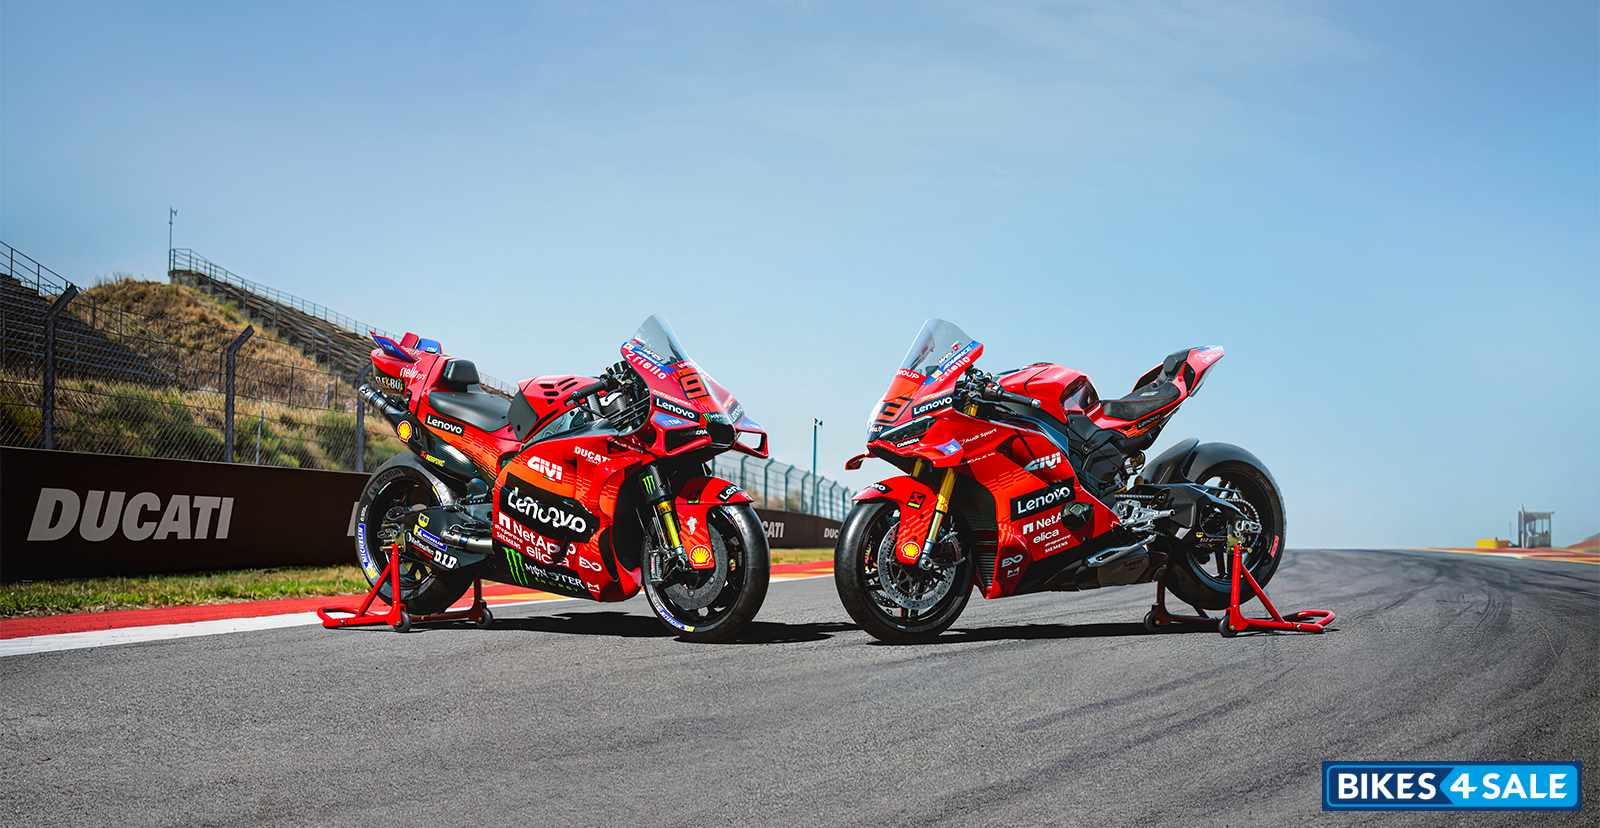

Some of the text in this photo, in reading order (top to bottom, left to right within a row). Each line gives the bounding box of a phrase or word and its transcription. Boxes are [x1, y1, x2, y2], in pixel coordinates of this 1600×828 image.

[656, 398, 696, 420] Lenovo
[913, 397, 952, 414] Lenovo
[427, 415, 462, 435] Lenovo
[527, 455, 562, 480] GIVI
[1017, 486, 1071, 514] Lenovo
[27, 487, 235, 542] DUCATI
[763, 521, 785, 538] CATI
[1032, 529, 1060, 544] elica
